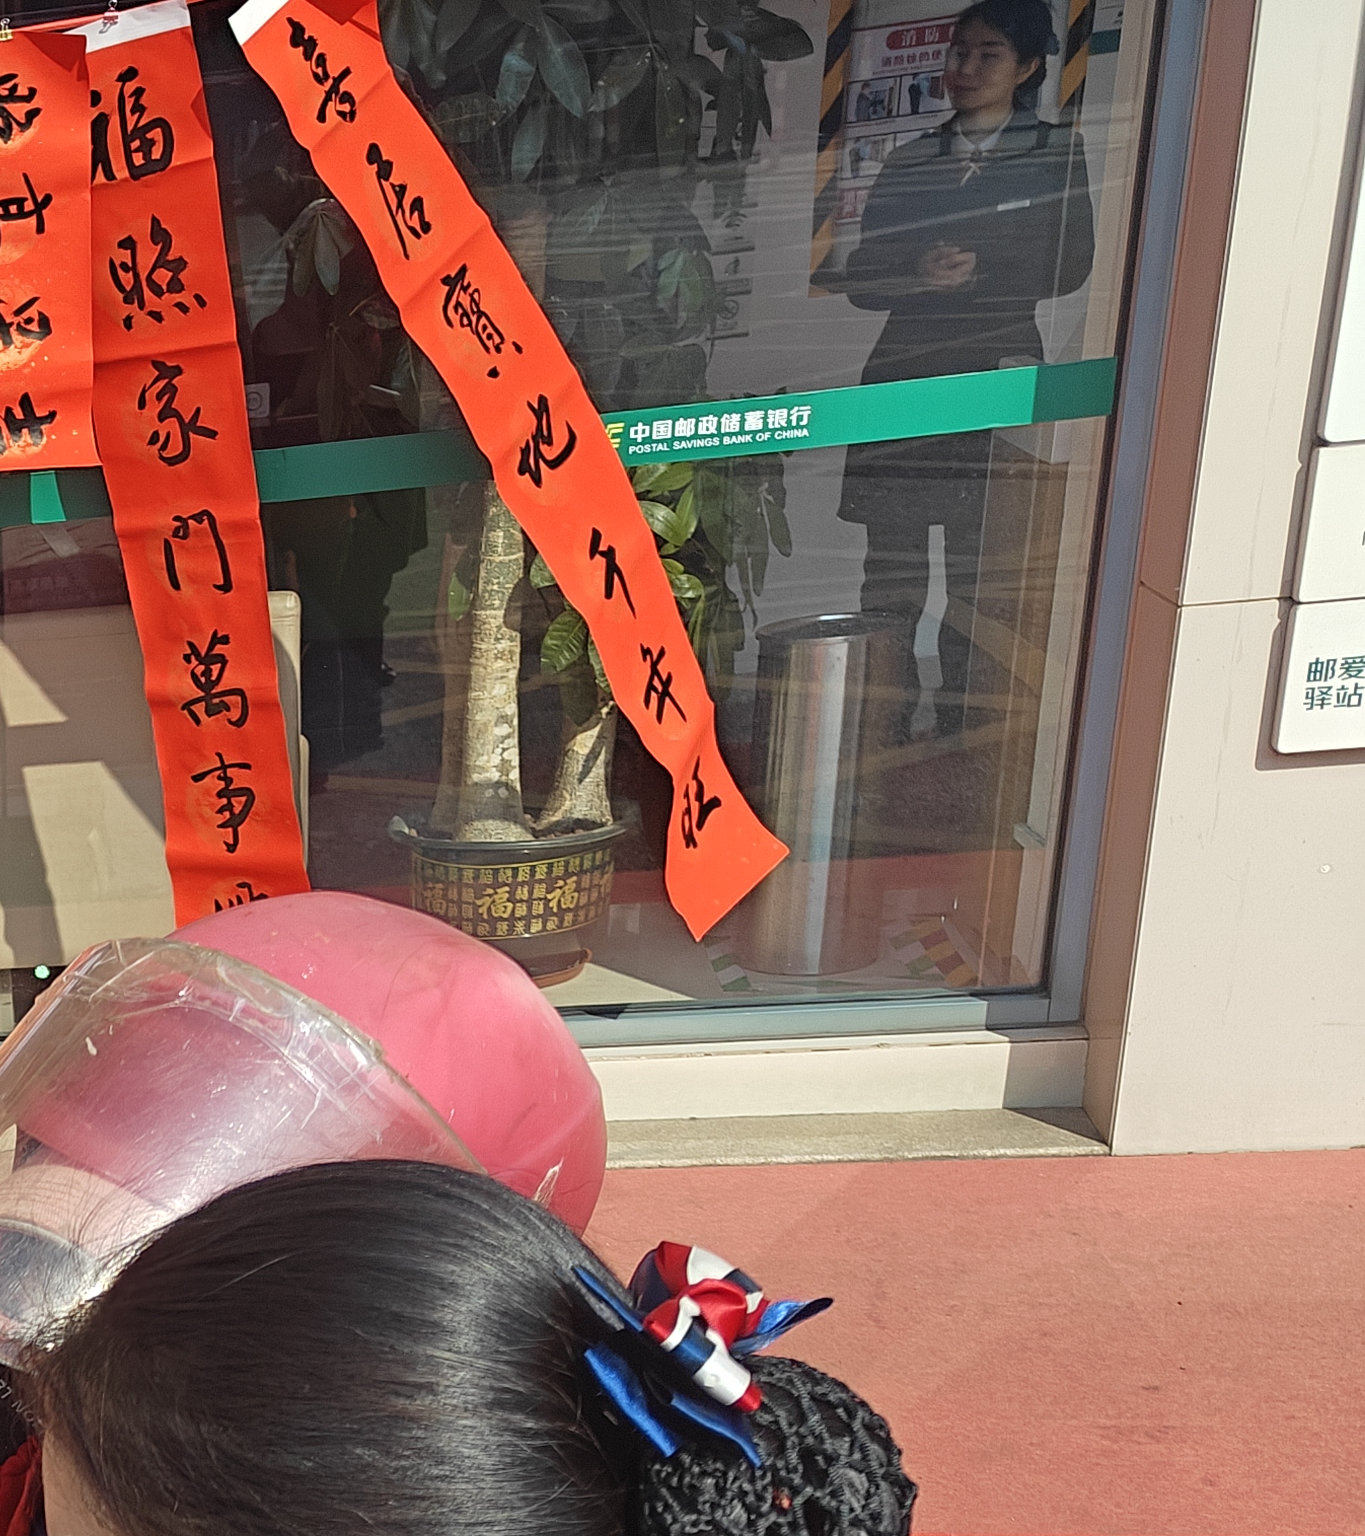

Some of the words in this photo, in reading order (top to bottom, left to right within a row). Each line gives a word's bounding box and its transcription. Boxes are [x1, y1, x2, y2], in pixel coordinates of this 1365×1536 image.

[629, 405, 812, 441] 中国邮政储蓄银行
[629, 444, 669, 455] POSTAL
[672, 439, 720, 451] SAVINGS
[722, 435, 753, 446] BANK
[756, 432, 771, 443] OF
[774, 427, 809, 440] CHINA
[1305, 655, 1365, 683] 邮爱
[1303, 684, 1363, 711] 驿站
[474, 886, 514, 919] 福
[546, 876, 580, 913] 福
